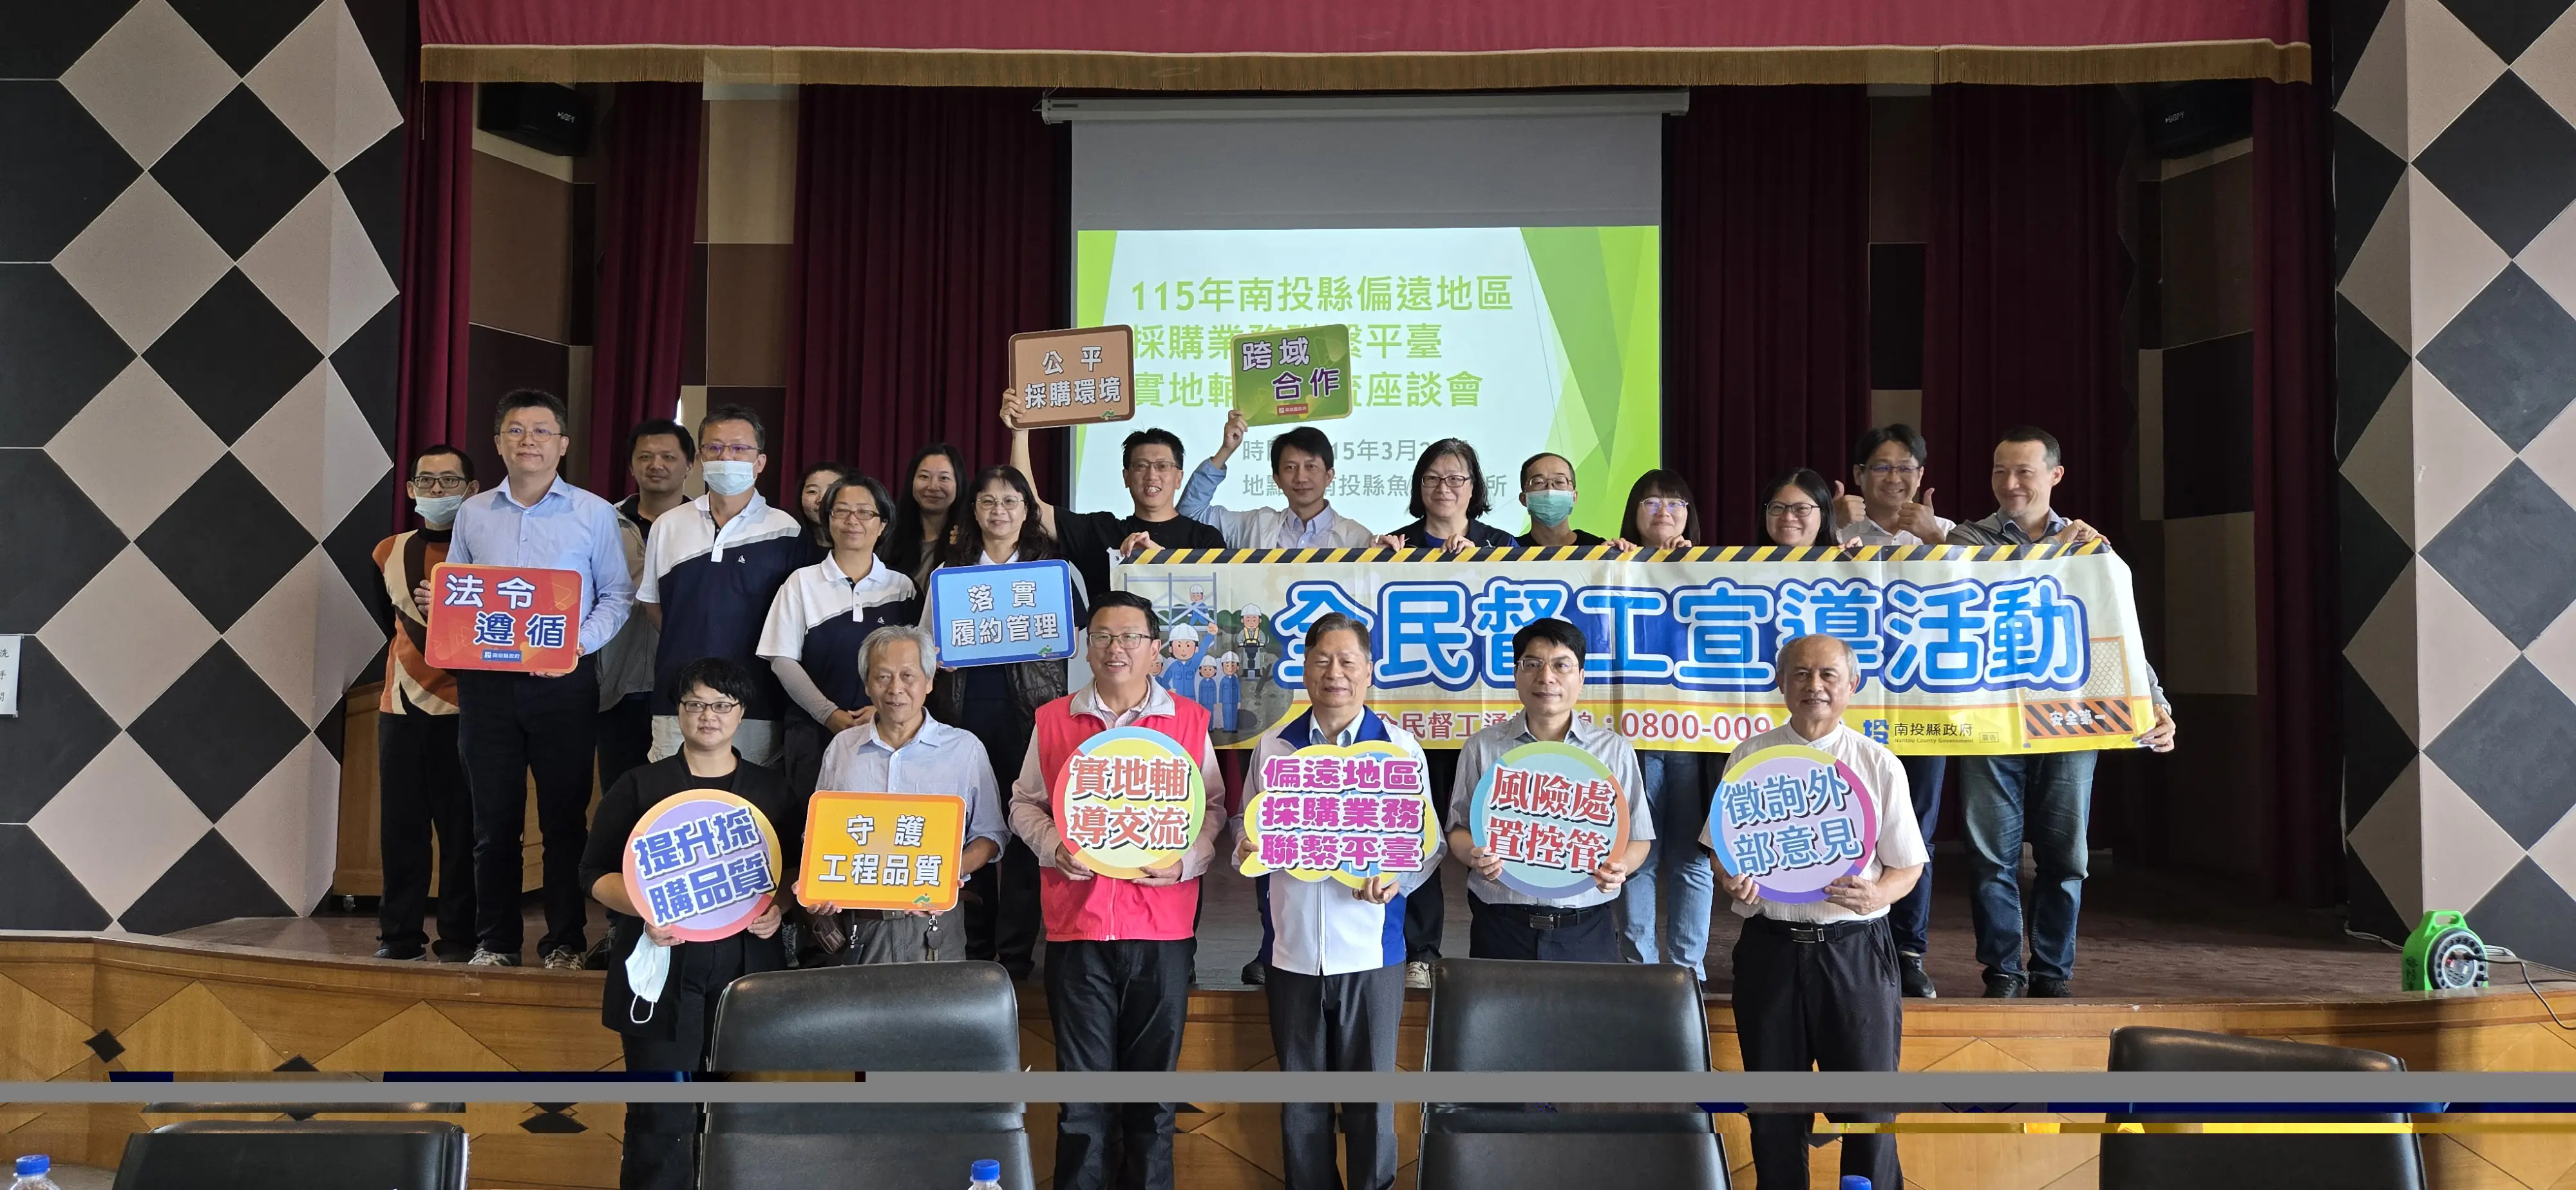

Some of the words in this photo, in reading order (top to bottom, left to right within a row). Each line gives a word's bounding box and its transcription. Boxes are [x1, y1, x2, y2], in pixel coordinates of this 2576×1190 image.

[1132, 275, 1513, 312] 115年南投縣偏遠地區
[1134, 323, 1443, 359] 採購業平臺
[1242, 336, 1310, 372] 跨域
[1042, 346, 1102, 375] 公平
[1025, 376, 1121, 410] 採購環境
[1135, 371, 1483, 407] 實地輔座談會
[1271, 368, 1340, 401] 合作
[444, 574, 536, 609] 法令
[967, 580, 1037, 612] 落實
[473, 611, 566, 648] 遵循
[951, 612, 1059, 647] 履約管理
[1894, 722, 1973, 737] 南投縣政府
[1070, 756, 1189, 800] 實地輔
[1262, 757, 1421, 791] 偏遠地區
[1490, 765, 1614, 823] 風險處
[1722, 765, 1848, 825] 徵詢外
[847, 815, 925, 847] 守護
[1068, 805, 1188, 849] 導交流
[1261, 795, 1422, 831] 採購業務
[632, 807, 761, 880] 提升採
[1259, 832, 1421, 870] 聯繫平臺
[1487, 815, 1607, 871] 置控管
[1733, 816, 1861, 874] 部意見
[819, 853, 942, 887] 工程品質
[647, 851, 775, 926] 購品質
